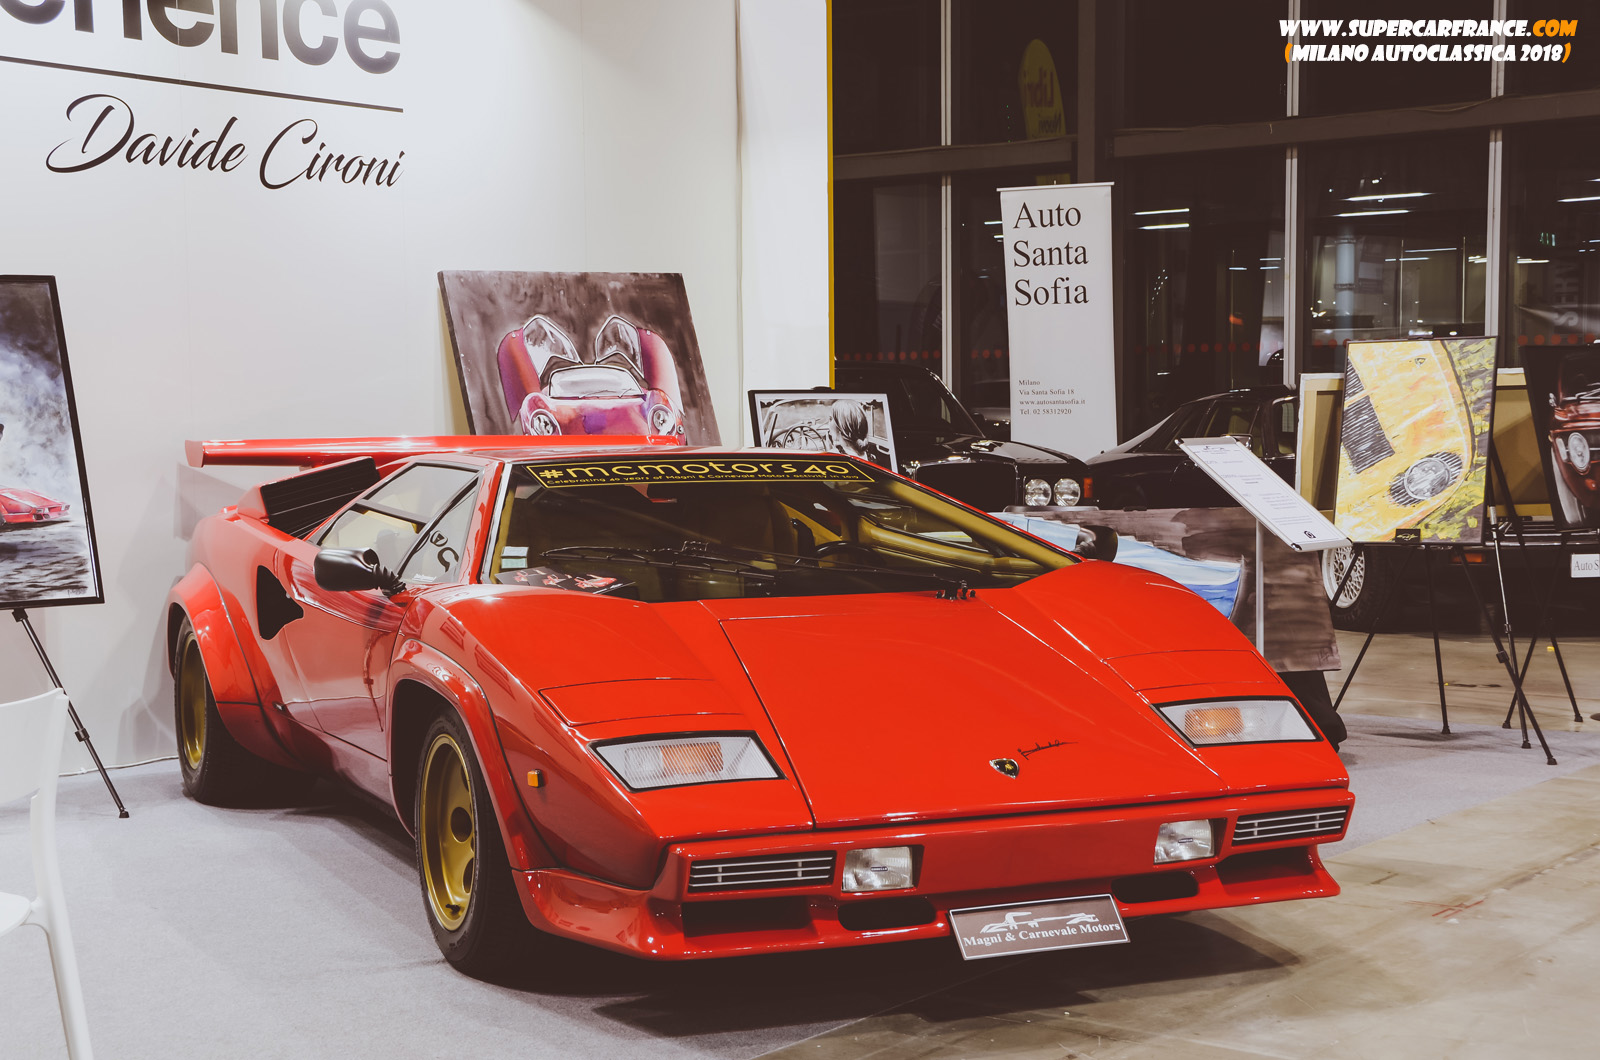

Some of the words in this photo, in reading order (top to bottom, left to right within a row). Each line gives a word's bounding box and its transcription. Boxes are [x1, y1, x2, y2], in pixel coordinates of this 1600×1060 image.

[46, 94, 248, 173] Davide
[260, 119, 405, 190] Cironi
[1013, 202, 1081, 229] Auto
[1013, 240, 1089, 267] Santa
[1014, 277, 1089, 306] Sofia
[547, 477, 606, 485] Celebrating
[1574, 560, 1593, 571] Auto
[963, 935, 1002, 947] Magni
[1005, 932, 1017, 942] &
[1019, 926, 1078, 940] Carnevale
[1080, 923, 1121, 935] Motors
